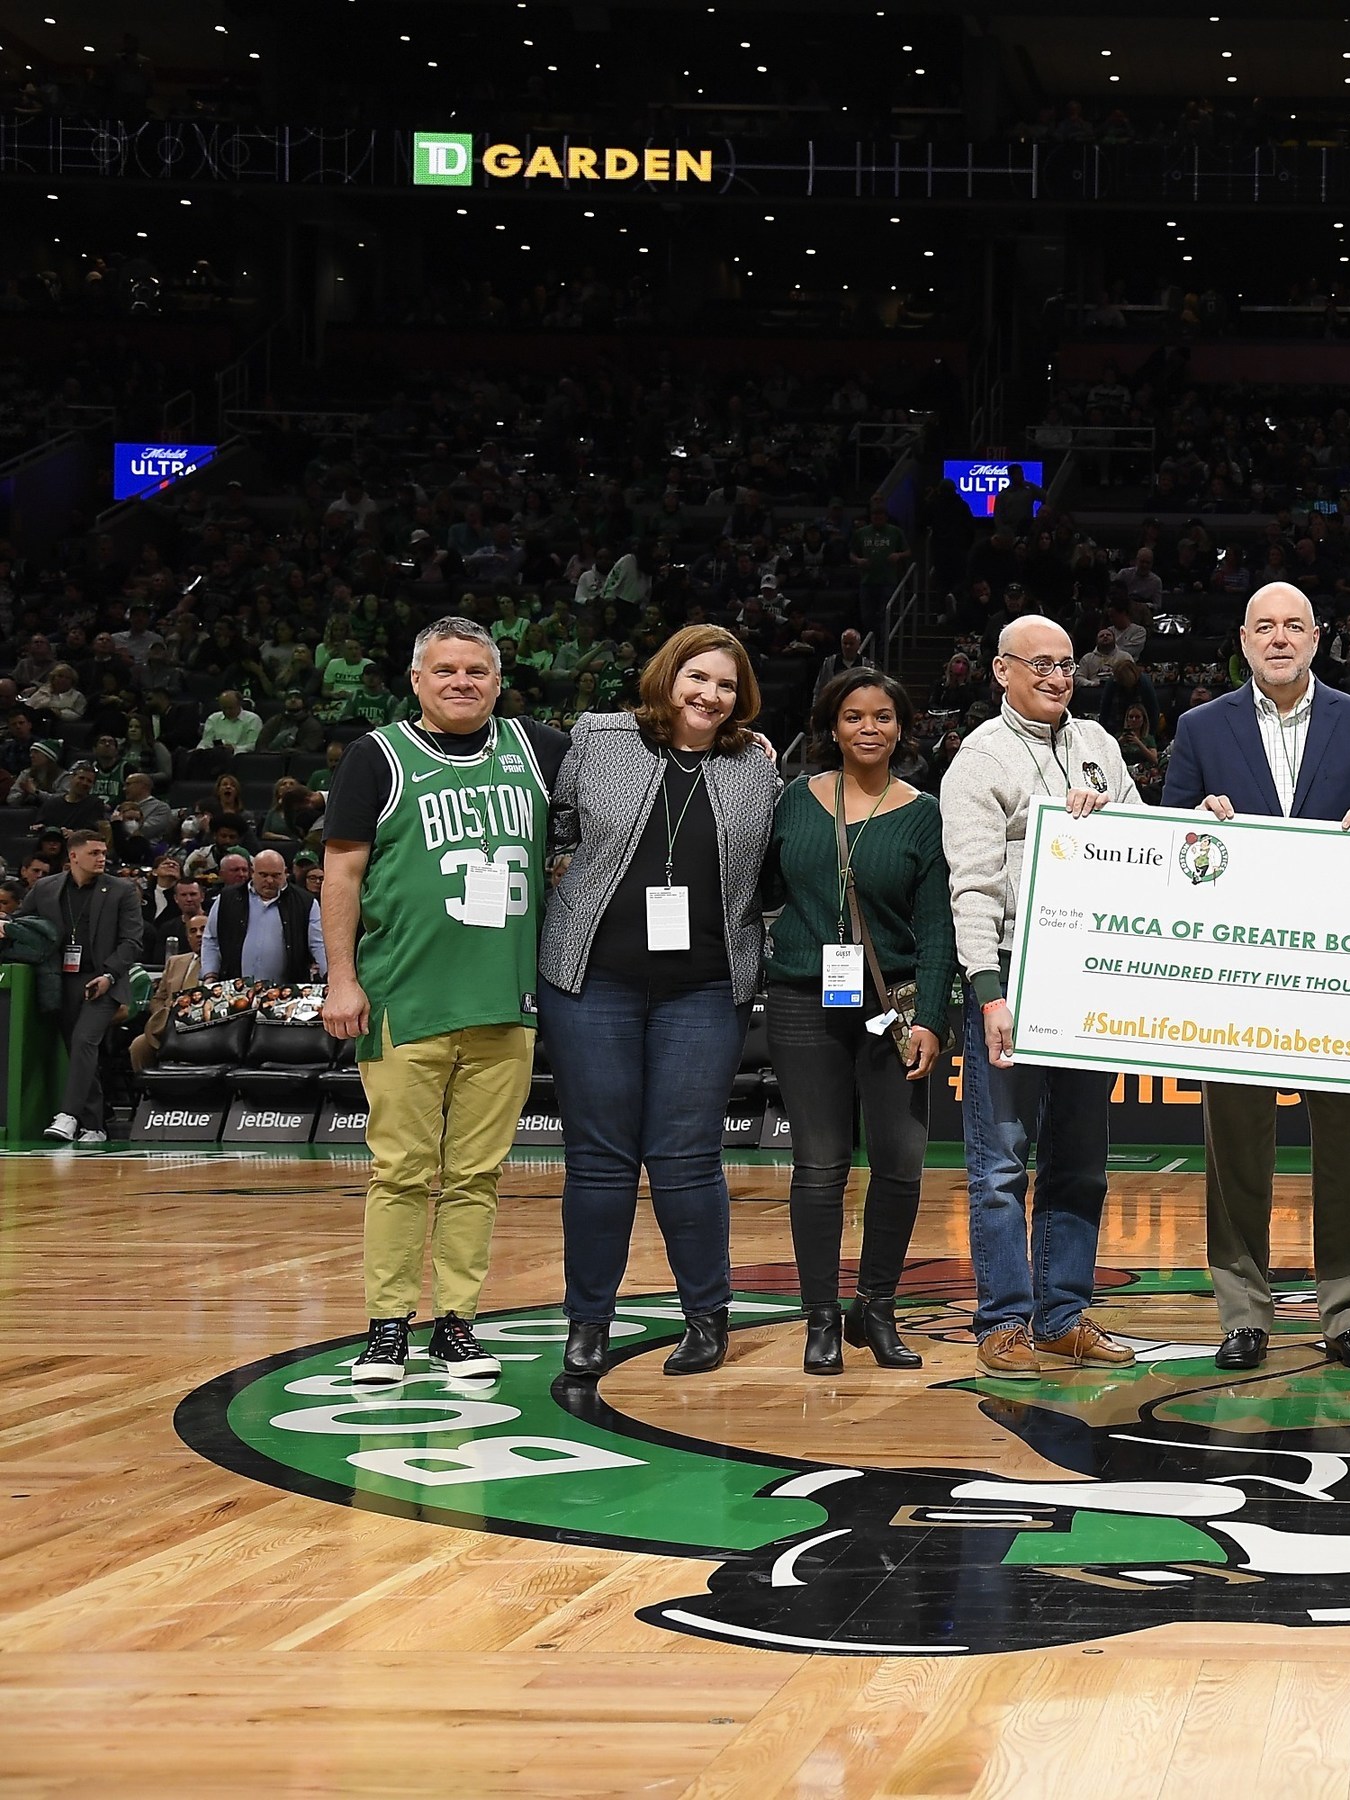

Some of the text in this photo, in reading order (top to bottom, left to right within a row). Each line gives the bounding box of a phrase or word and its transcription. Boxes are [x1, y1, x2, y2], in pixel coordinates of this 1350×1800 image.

[417, 141, 713, 182] TD GARDEN
[960, 477, 1010, 492] ULTR
[498, 754, 524, 765] VISTA
[502, 764, 526, 773] PRINT
[417, 784, 534, 851] BOSTON
[1083, 843, 1163, 866] Sun Life
[440, 845, 529, 922] 36
[1039, 917, 1066, 929] Order
[1068, 920, 1080, 930] of
[1040, 906, 1084, 921] Pay to the
[1092, 912, 1163, 936] YMCA
[1171, 920, 1205, 940] OF
[1212, 924, 1316, 950] GREATER
[835, 950, 852, 958] GUEST
[1084, 956, 1124, 973] ONE
[1127, 961, 1214, 981] HUNDRED
[1218, 969, 1262, 985] FIFTY
[1265, 973, 1302, 989] FIVE
[1028, 1024, 1058, 1036] Memo
[145, 1110, 211, 1130] jetBlue
[237, 1111, 303, 1131] jetBlue
